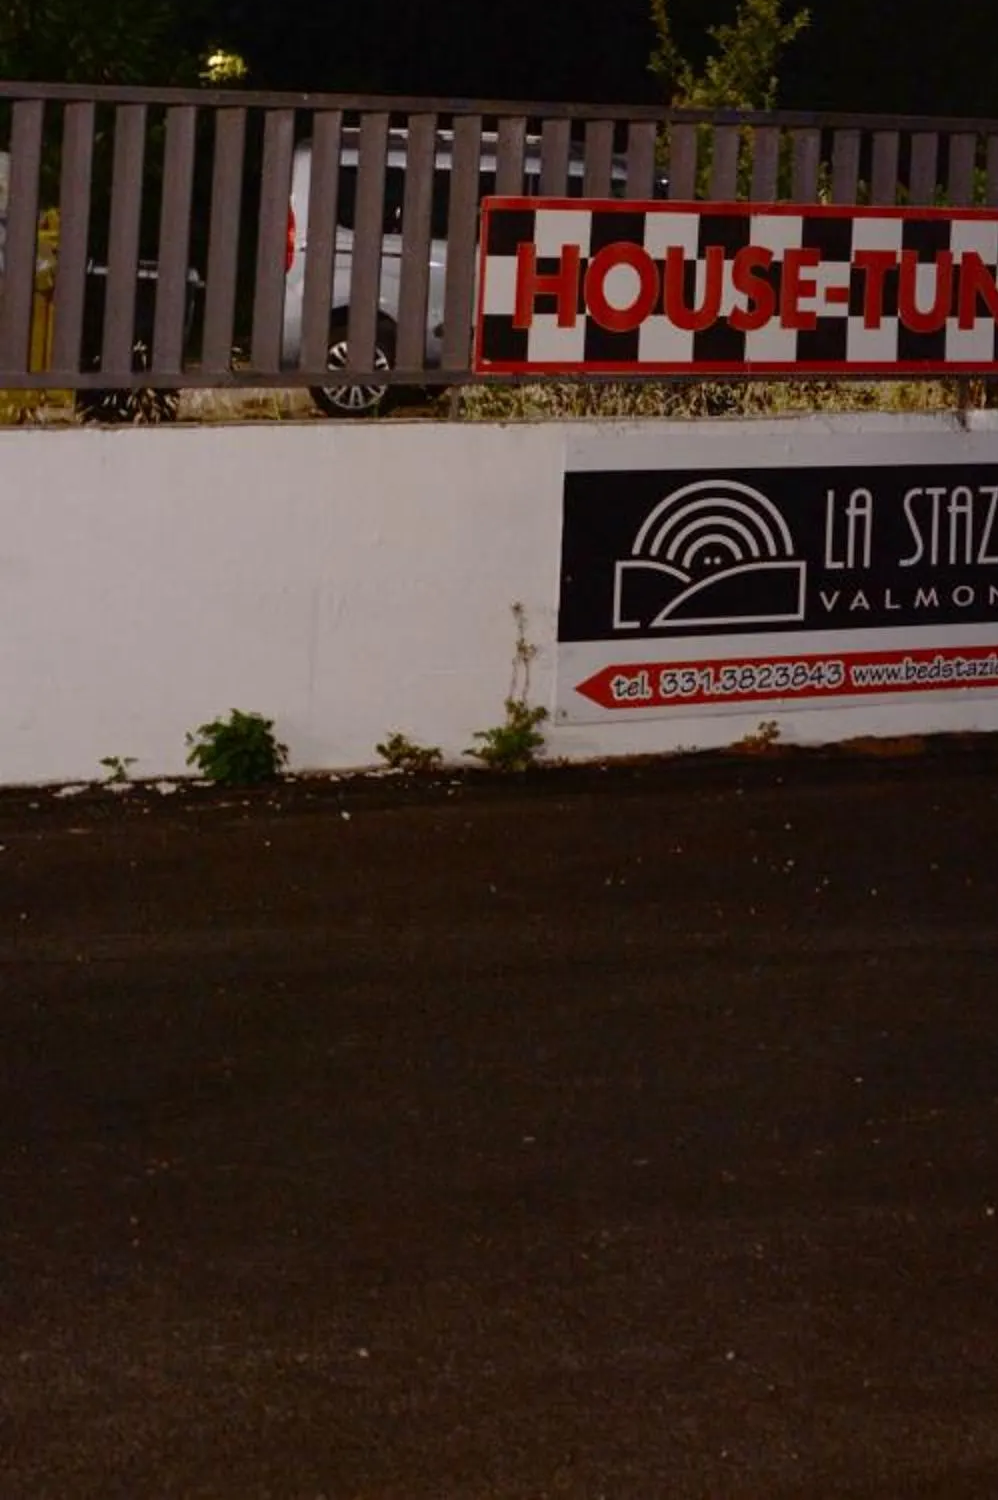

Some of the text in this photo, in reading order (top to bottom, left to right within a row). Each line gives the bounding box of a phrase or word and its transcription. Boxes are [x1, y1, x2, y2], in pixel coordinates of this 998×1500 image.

[824, 489, 873, 569] LA
[613, 673, 649, 697] tel.
[662, 663, 842, 695] 331.3823843
